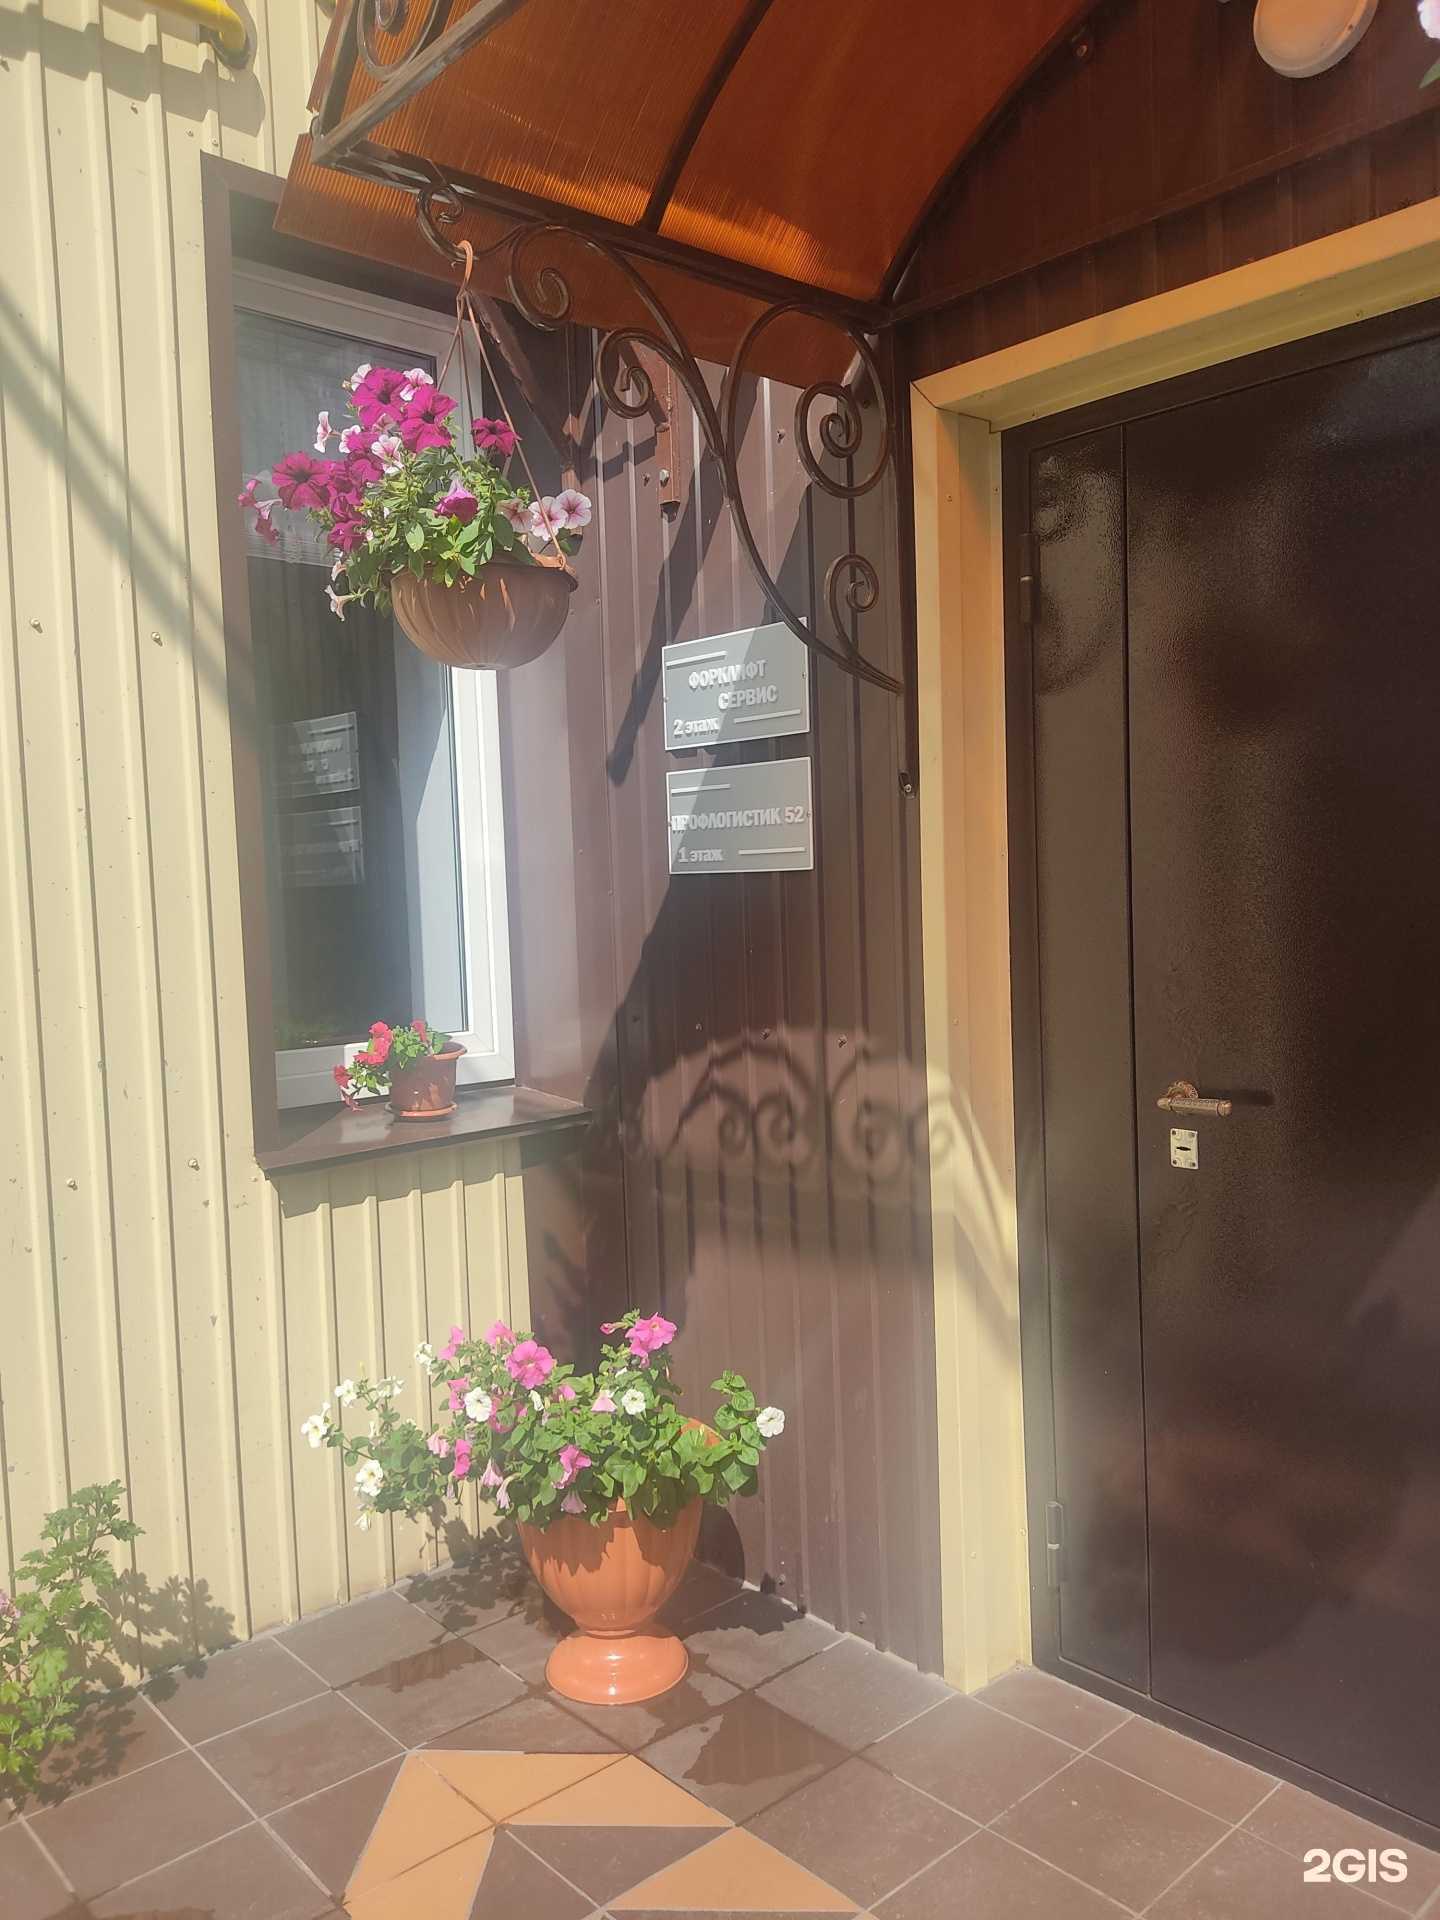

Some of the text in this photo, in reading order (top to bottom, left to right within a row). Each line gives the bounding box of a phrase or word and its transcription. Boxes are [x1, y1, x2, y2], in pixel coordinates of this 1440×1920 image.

[688, 659, 767, 689] ФОРКЛИФТ
[718, 685, 778, 710] СЕРВИС
[673, 717, 719, 736] 2 этаж
[672, 806, 804, 832] ПРОФЛОГИСТИК 52
[678, 847, 724, 862] 1 этаж
